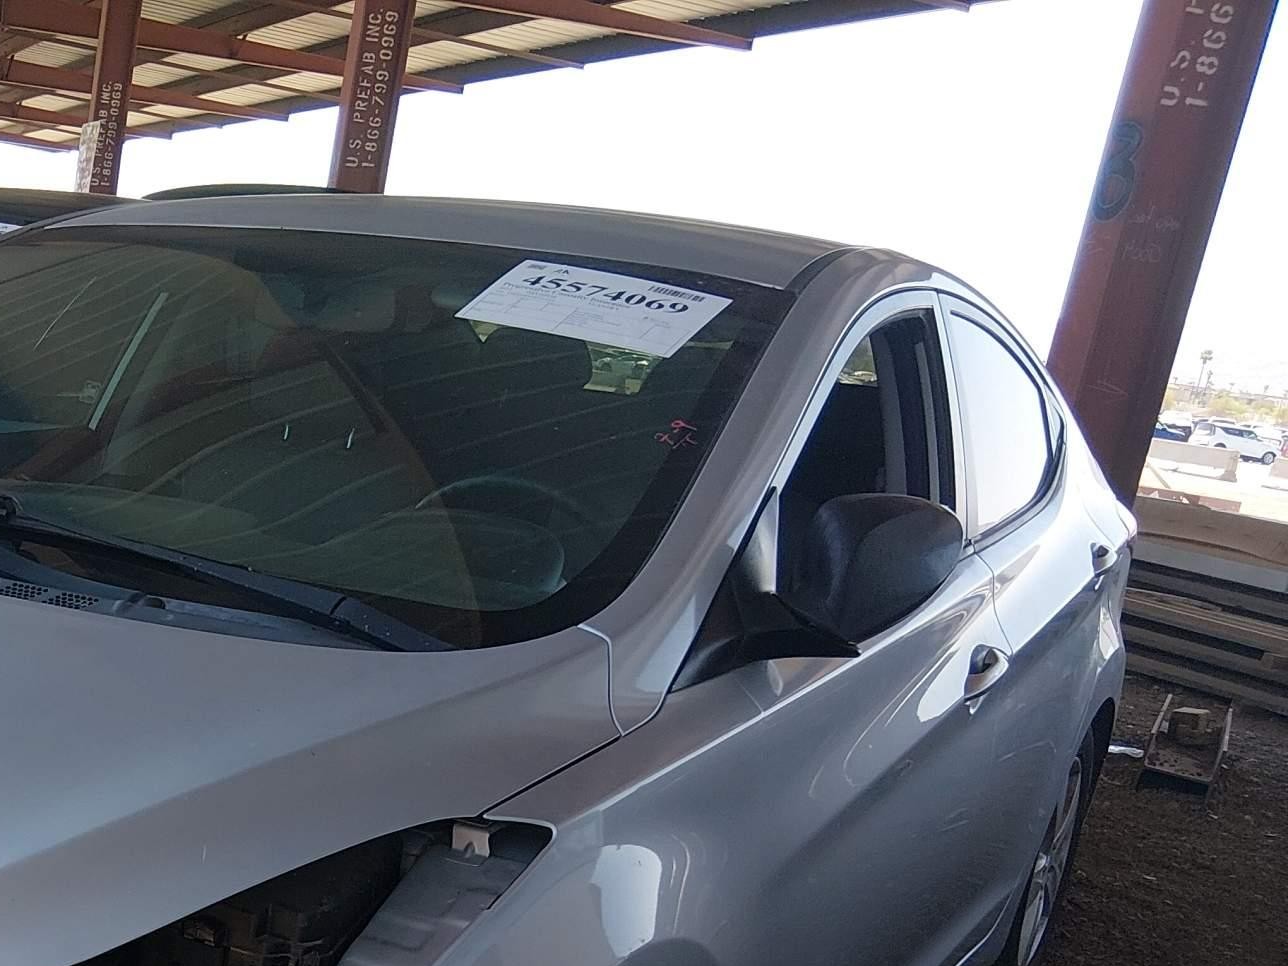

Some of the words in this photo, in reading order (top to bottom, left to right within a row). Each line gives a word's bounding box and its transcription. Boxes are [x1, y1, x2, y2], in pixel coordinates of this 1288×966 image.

[100, 80, 113, 105] INC.
[353, 52, 377, 123] PREFAB
[365, 8, 384, 42] INC.
[361, 11, 399, 168] 1-866-799-0969
[100, 82, 123, 187] 1-866-799-0969
[521, 275, 689, 314] 45574069
